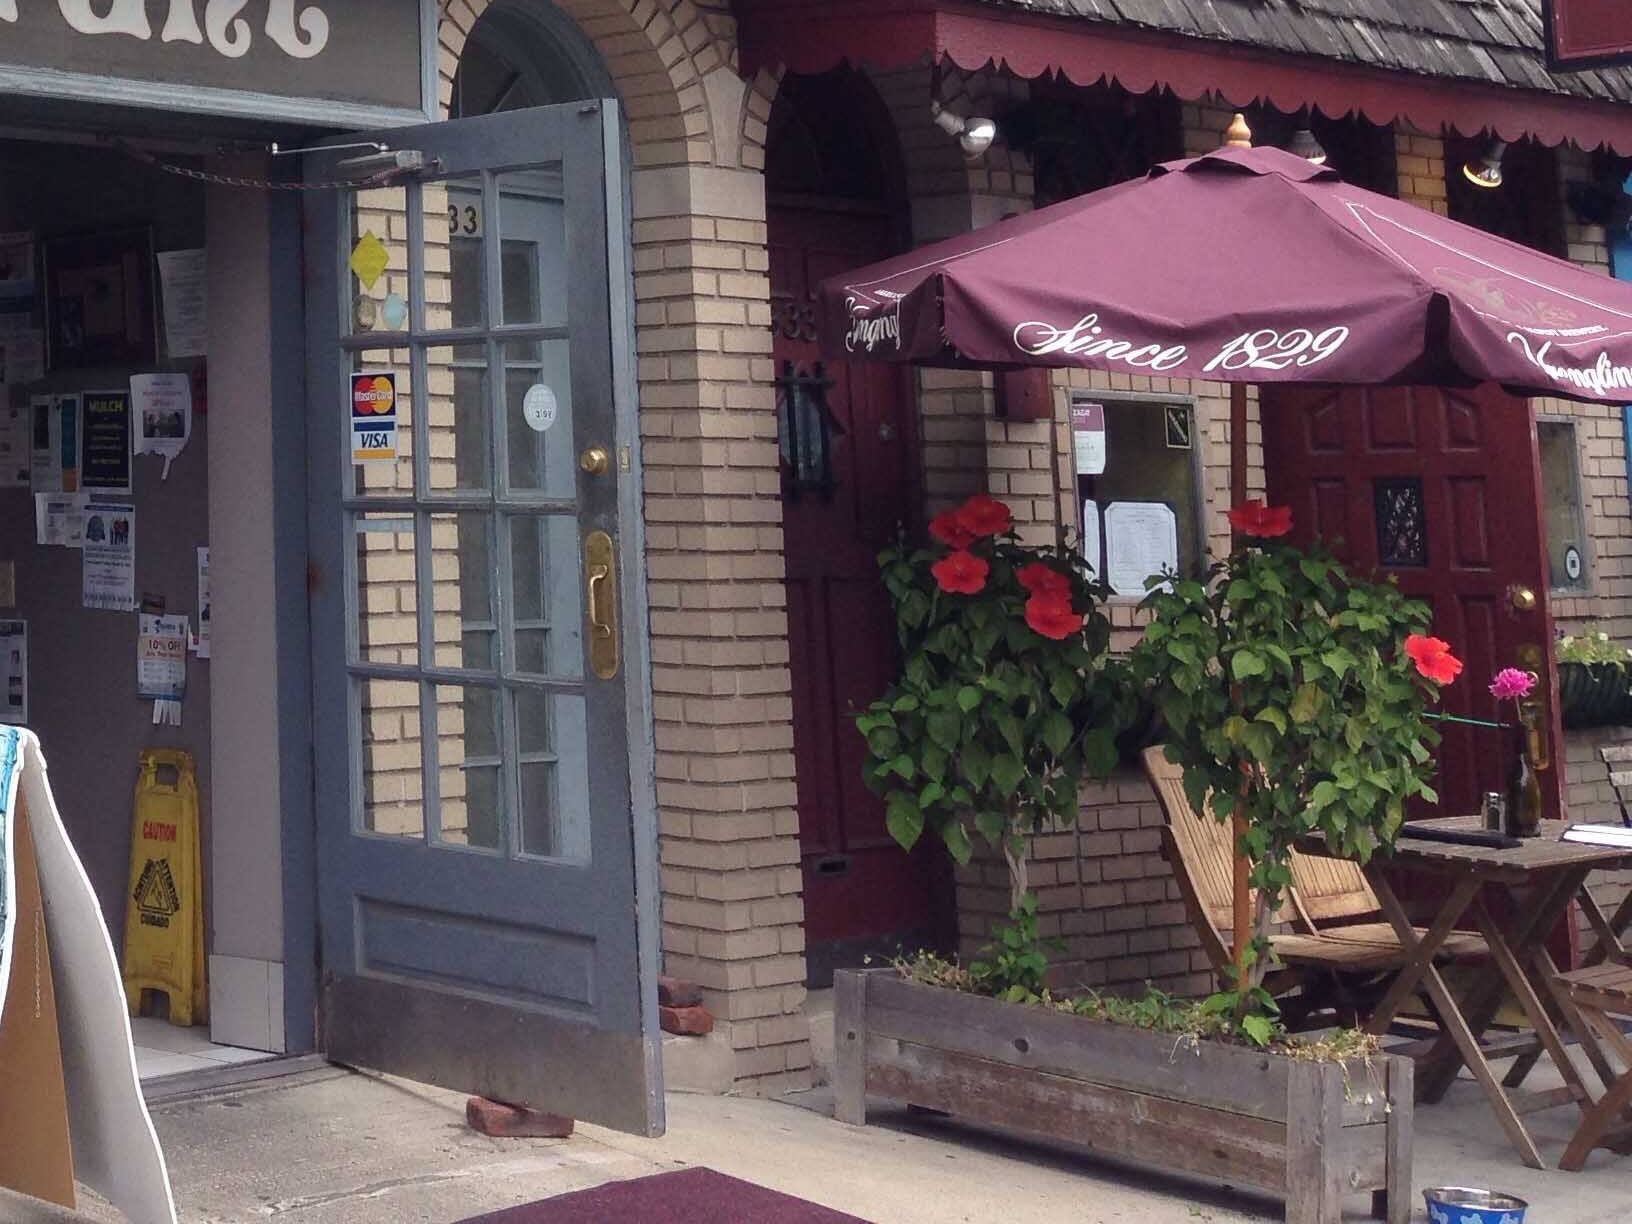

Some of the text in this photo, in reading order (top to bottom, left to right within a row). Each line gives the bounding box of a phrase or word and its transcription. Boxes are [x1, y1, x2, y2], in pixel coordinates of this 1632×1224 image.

[1014, 313, 1349, 372] Since 1829
[354, 391, 393, 402] MasterCard
[360, 433, 389, 448] VISA
[143, 819, 177, 841] CAUTION
